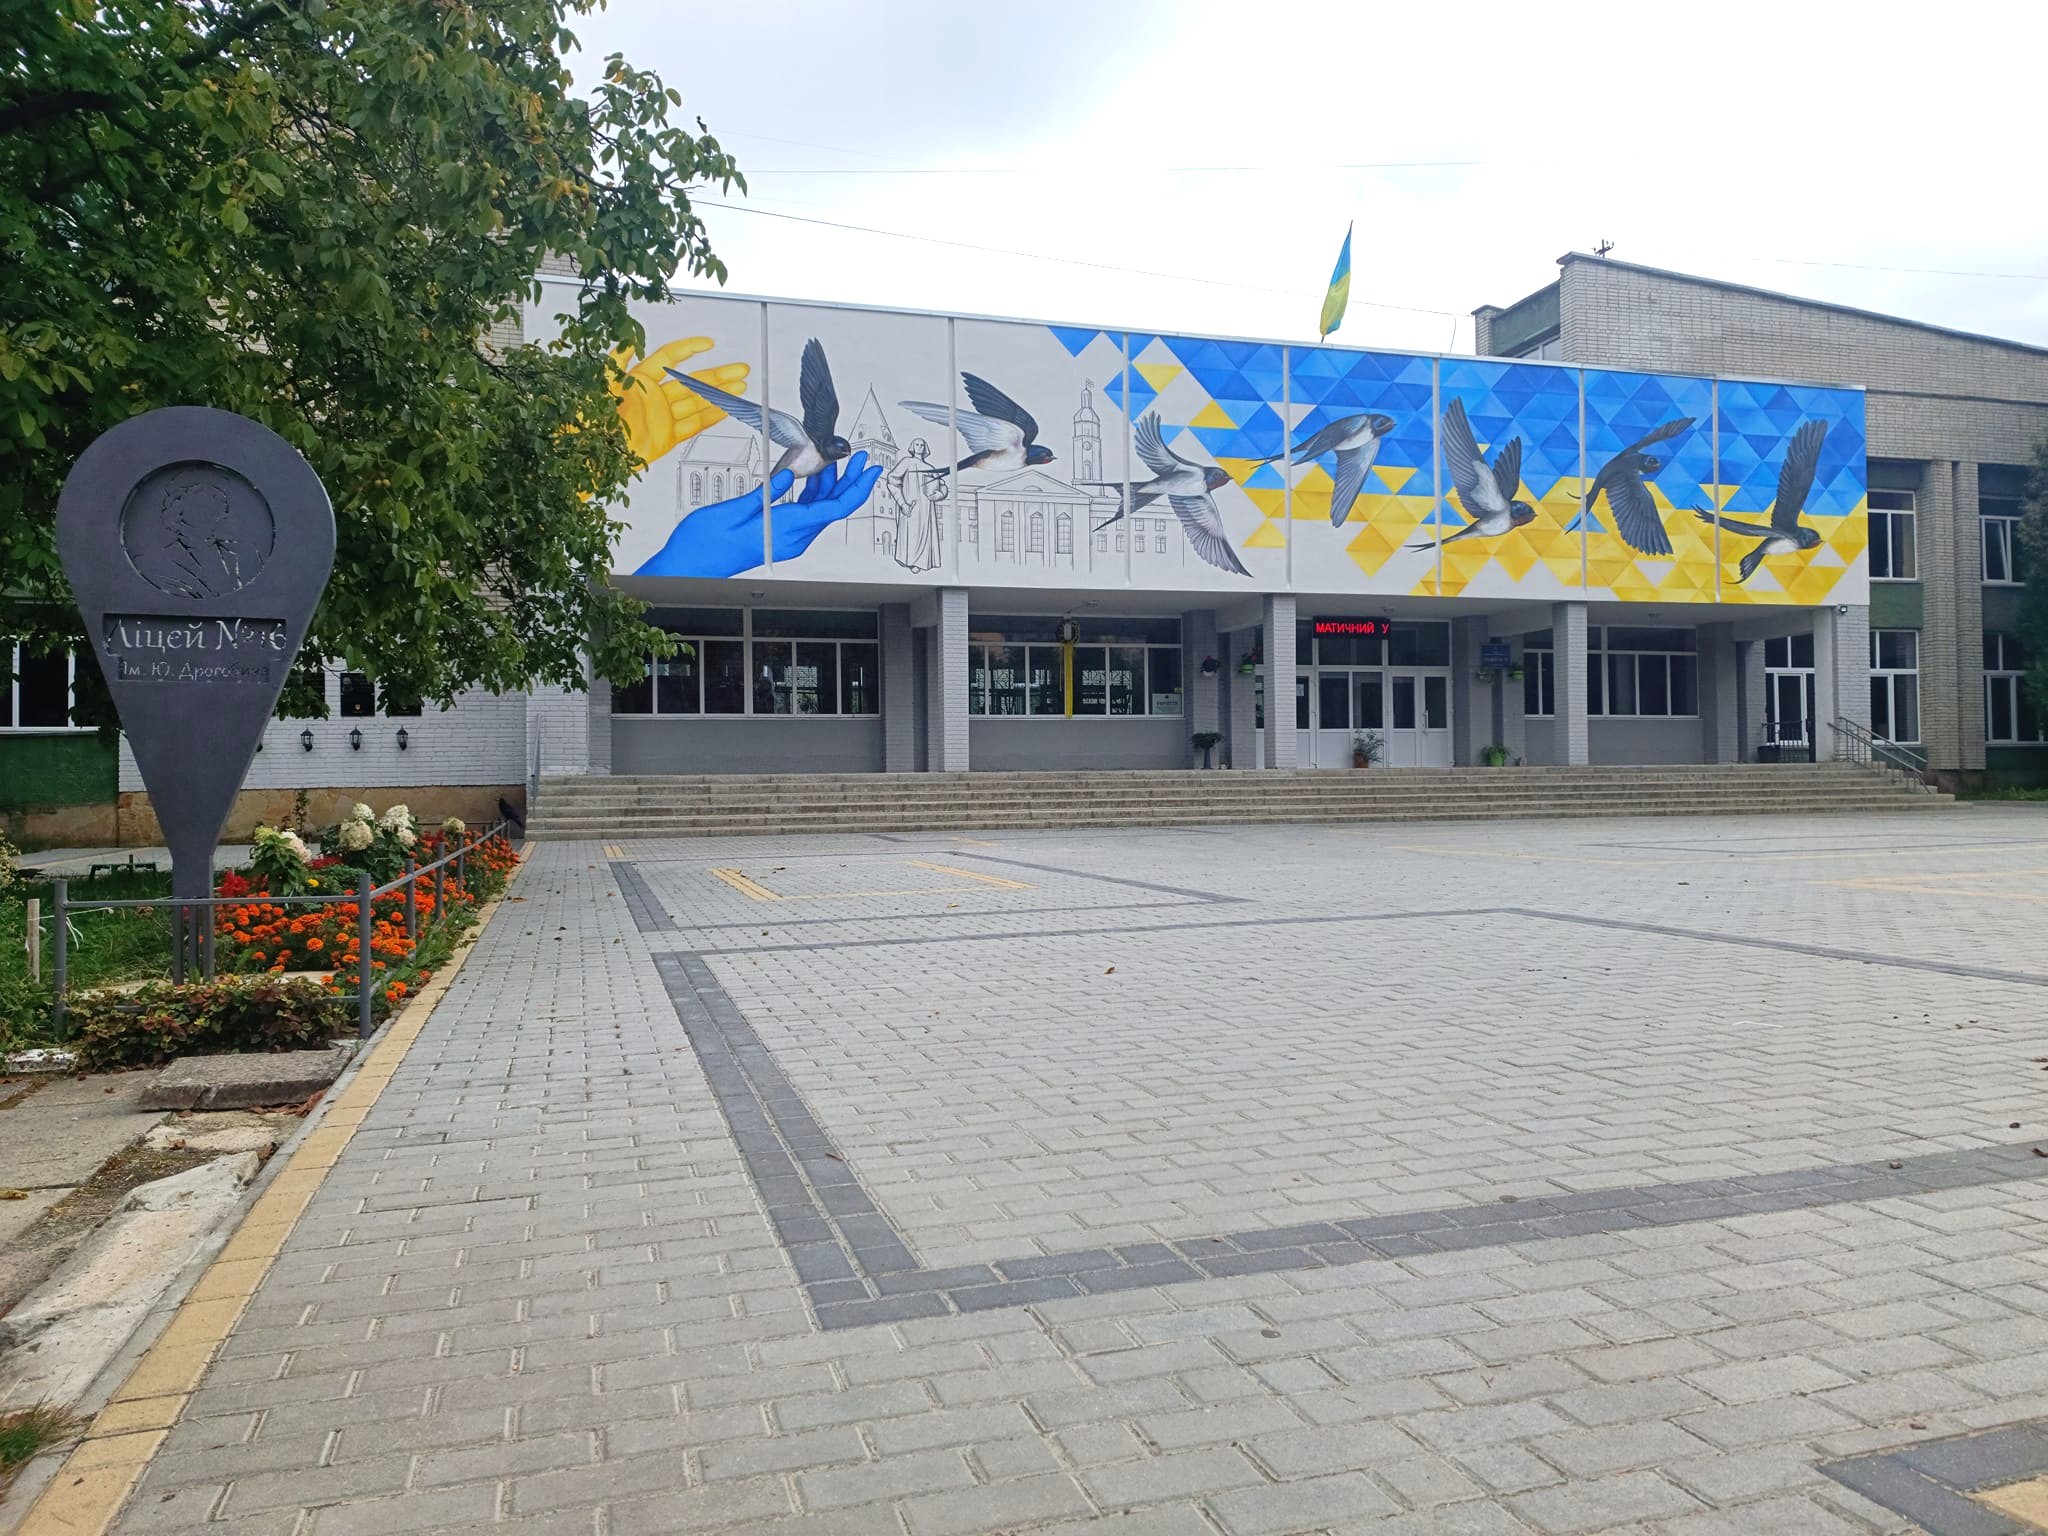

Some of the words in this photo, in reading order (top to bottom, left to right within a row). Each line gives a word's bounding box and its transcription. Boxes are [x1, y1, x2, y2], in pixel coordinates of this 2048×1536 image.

[103, 618, 207, 655] Ліцей
[1315, 621, 1375, 633] МАТИЧНИЙ
[1381, 623, 1389, 634] У
